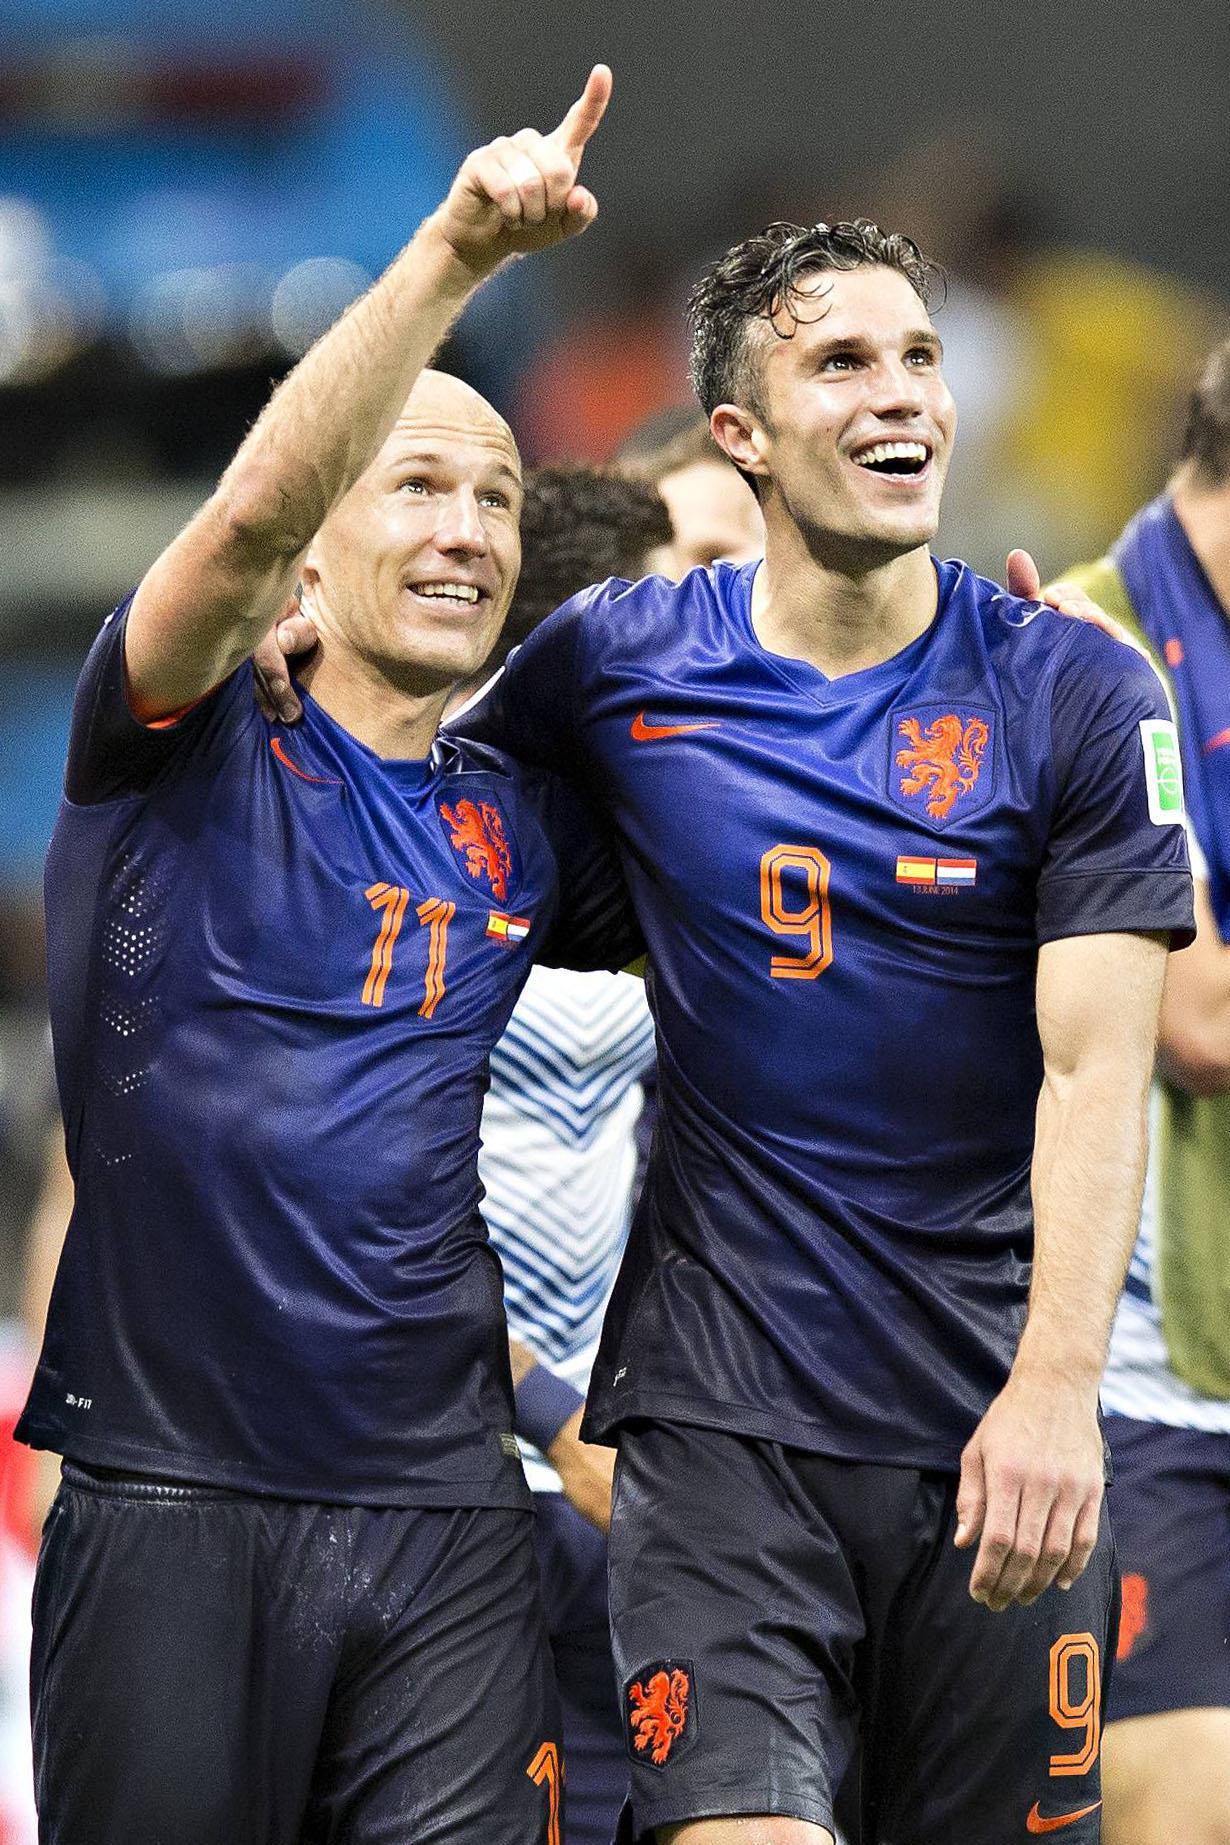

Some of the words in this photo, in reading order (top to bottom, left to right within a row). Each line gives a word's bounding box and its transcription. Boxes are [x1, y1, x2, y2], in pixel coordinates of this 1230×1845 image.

[362, 882, 456, 1019] 11
[760, 843, 833, 979] 9
[941, 886, 959, 895] 2014
[1049, 1631, 1100, 1776] 9
